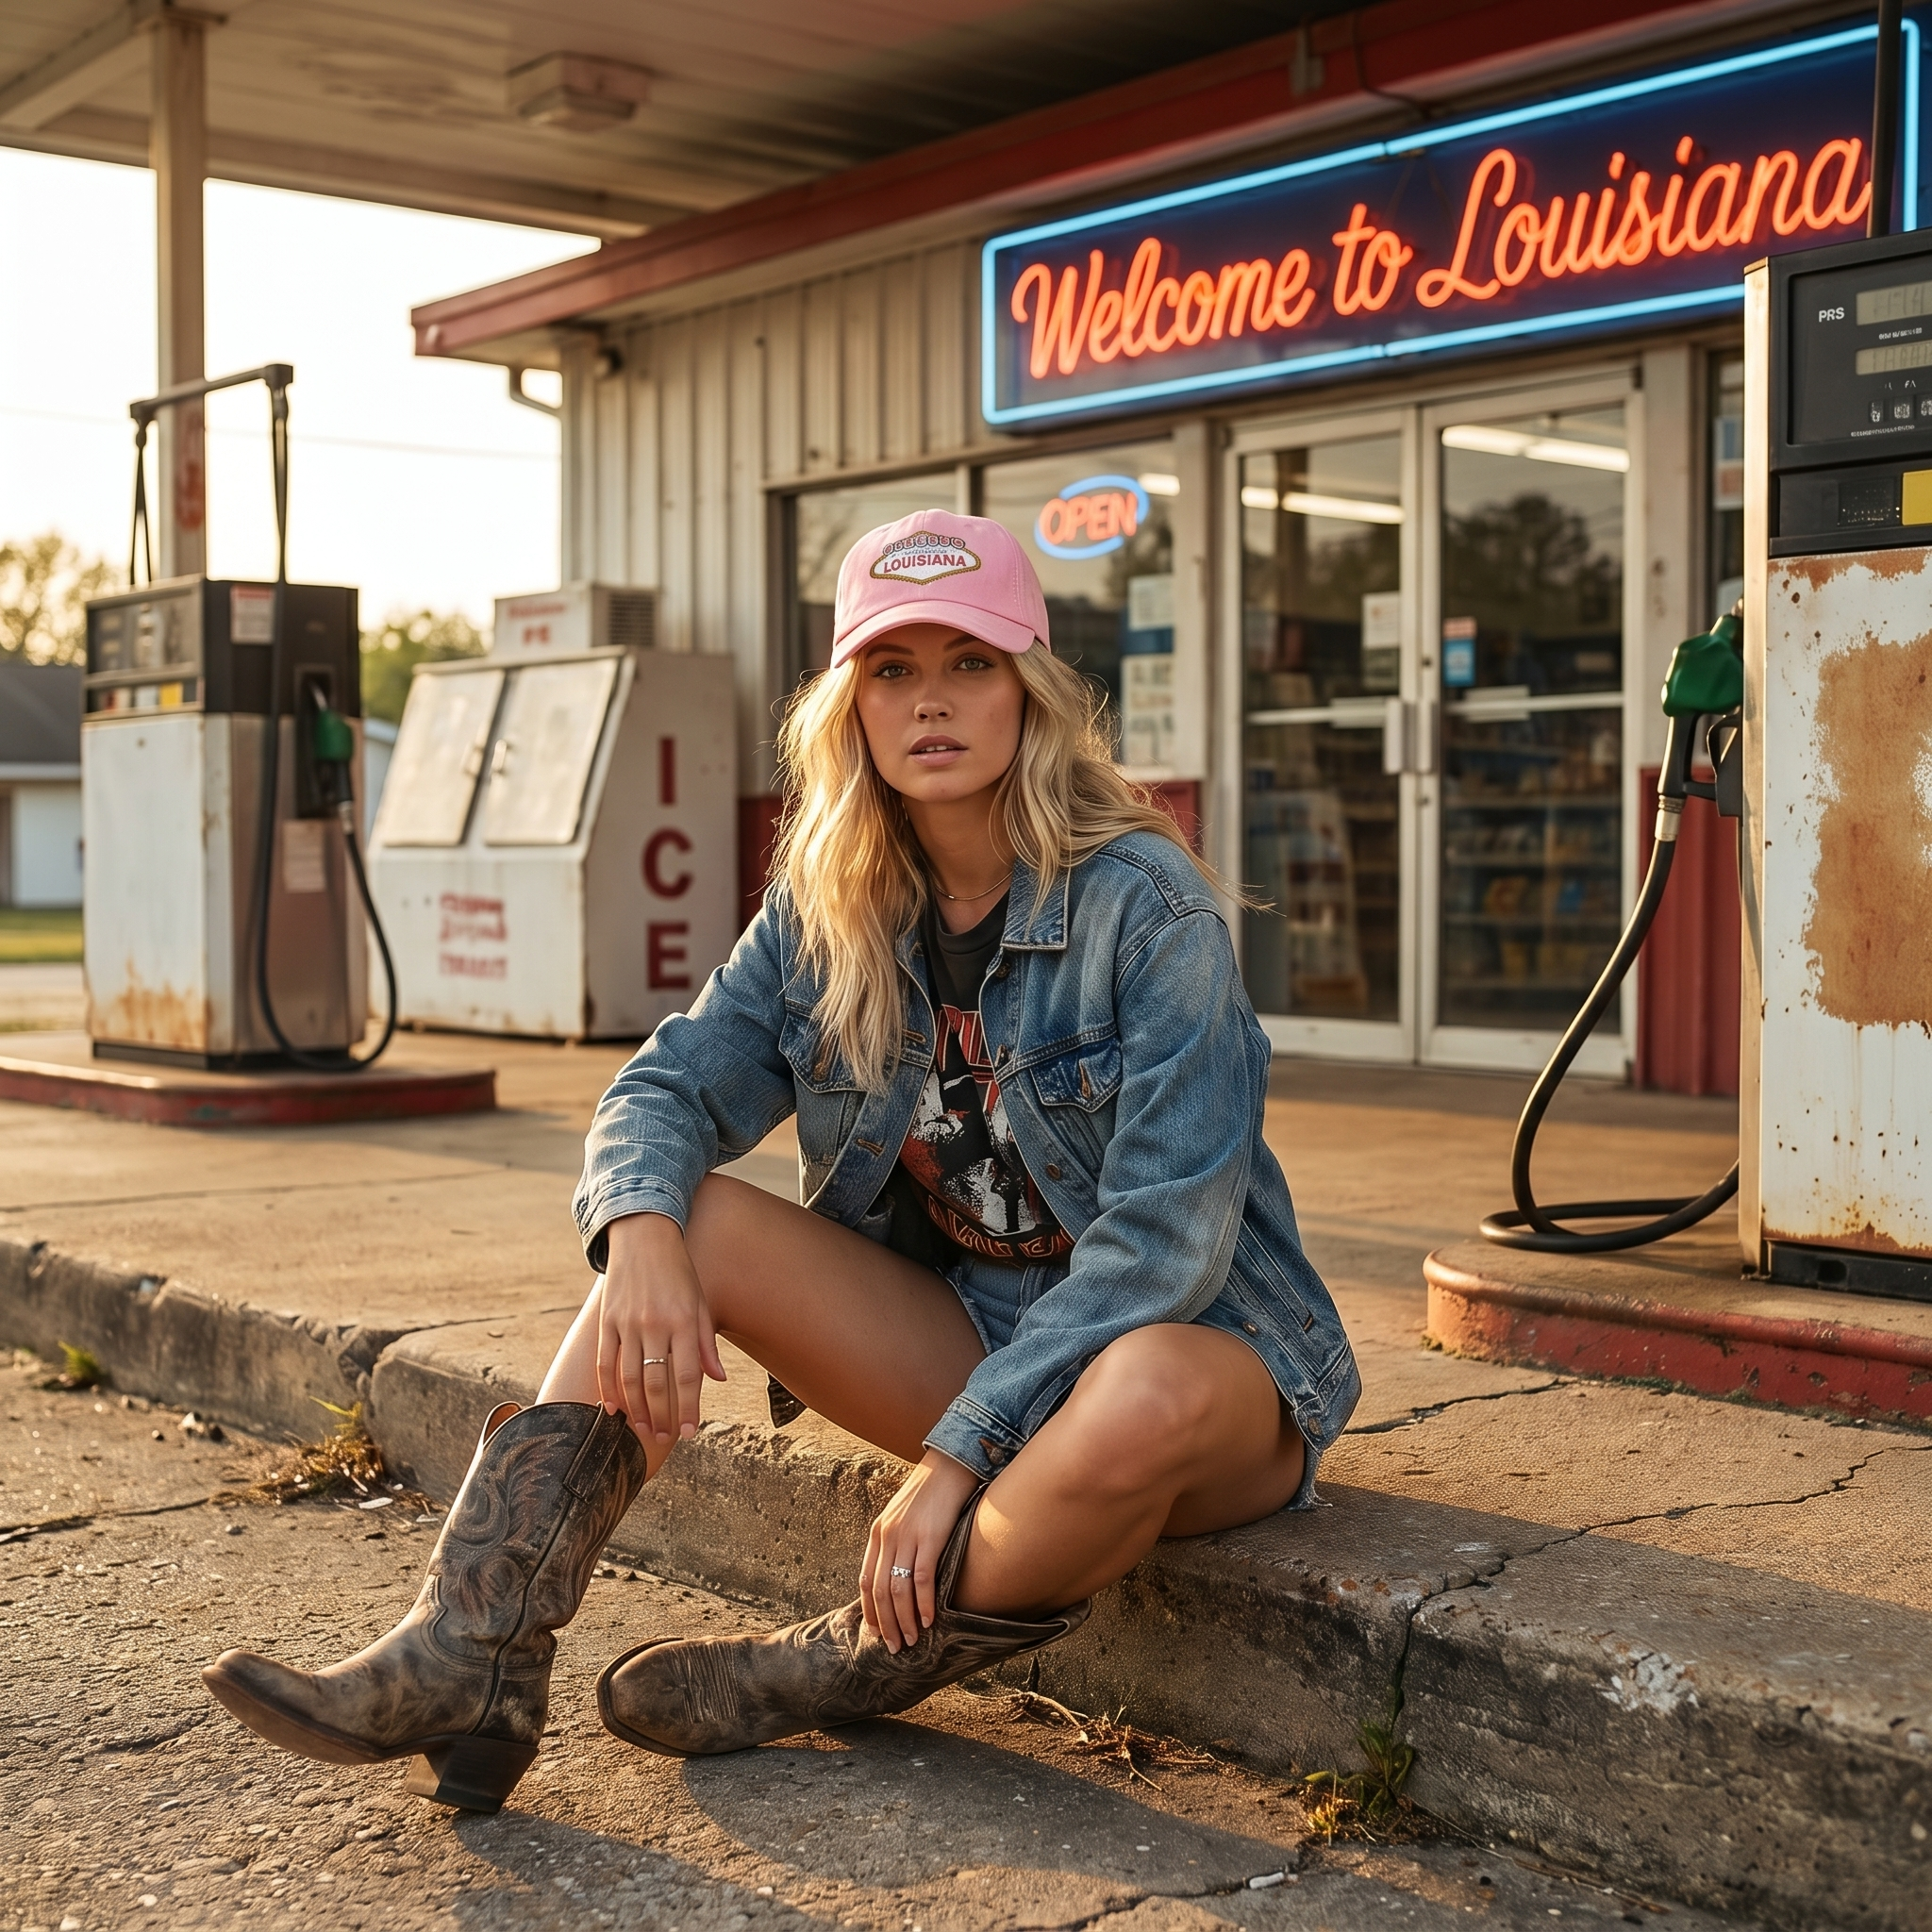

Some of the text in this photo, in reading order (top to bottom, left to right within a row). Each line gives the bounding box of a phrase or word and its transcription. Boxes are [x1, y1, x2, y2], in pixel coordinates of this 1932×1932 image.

[1010, 135, 1872, 379] Welcome to Louisiana
[1818, 307, 1845, 323] PRS
[1039, 490, 1138, 545] OPEN
[883, 554, 967, 574] LOUISIANA
[641, 736, 694, 992] ICE
